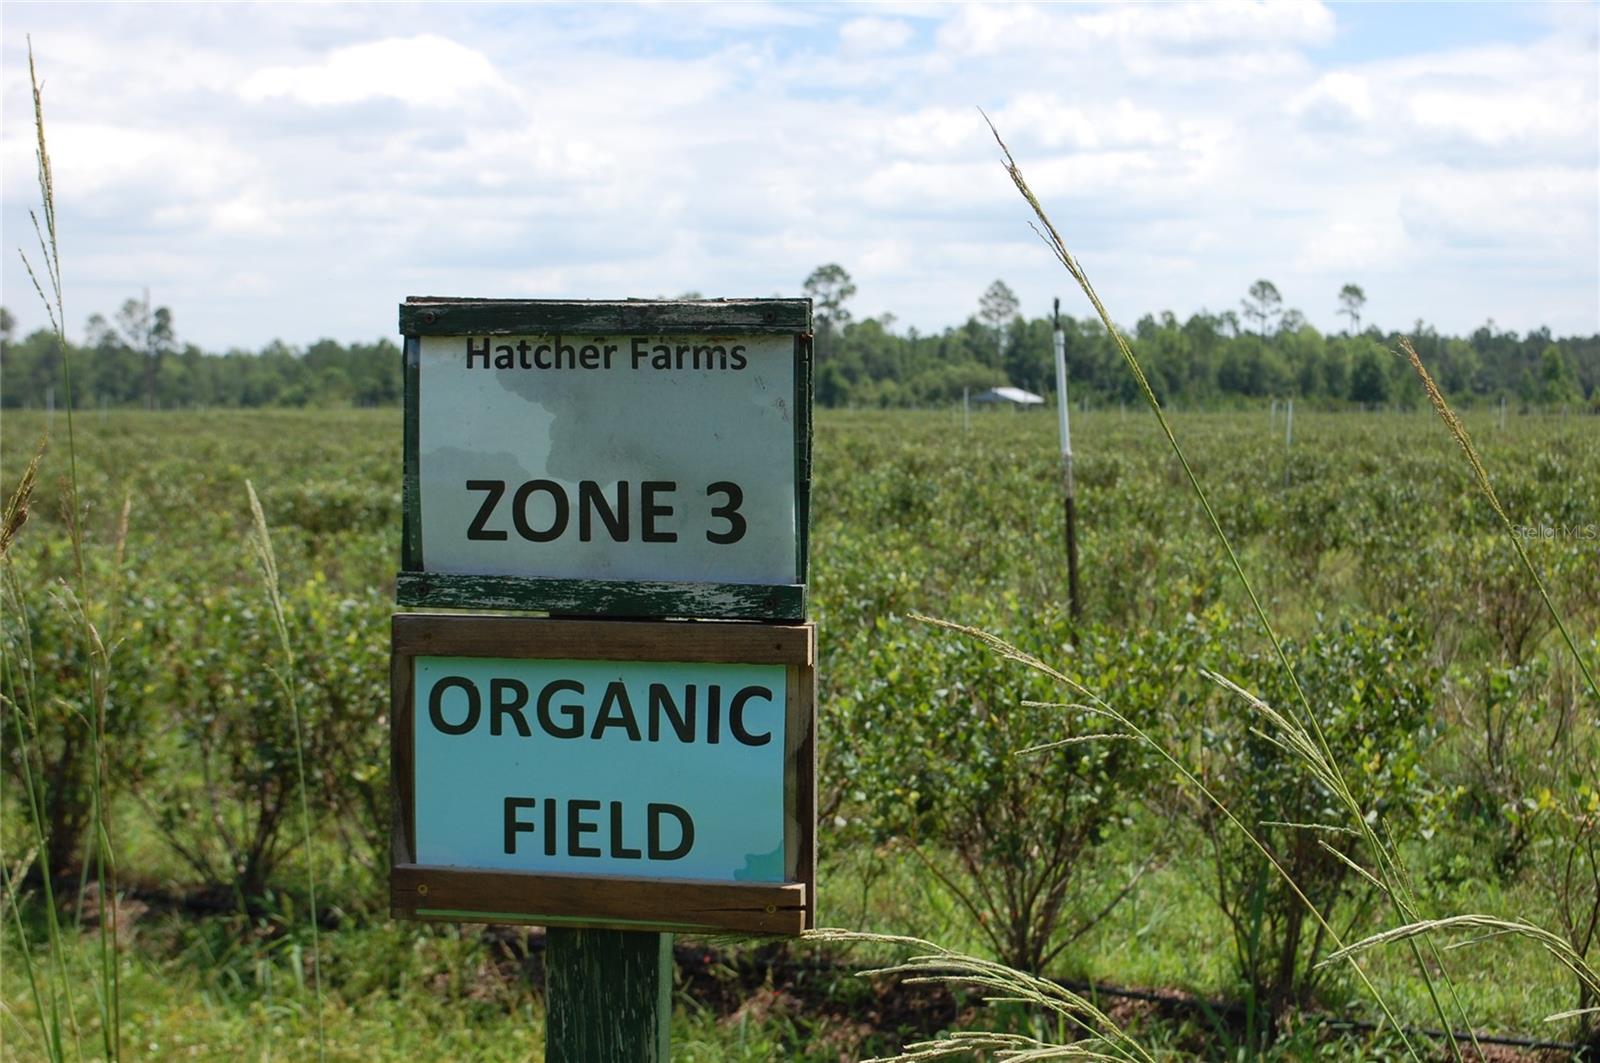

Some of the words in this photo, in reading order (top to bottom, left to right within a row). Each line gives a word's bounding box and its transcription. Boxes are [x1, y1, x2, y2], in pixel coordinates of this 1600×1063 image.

[465, 336, 618, 370] Hatcher
[630, 337, 748, 371] Farms
[465, 479, 679, 544] ZONE
[705, 480, 748, 546] 3
[428, 675, 773, 747] ORGANIC
[503, 796, 695, 861] FIELD
